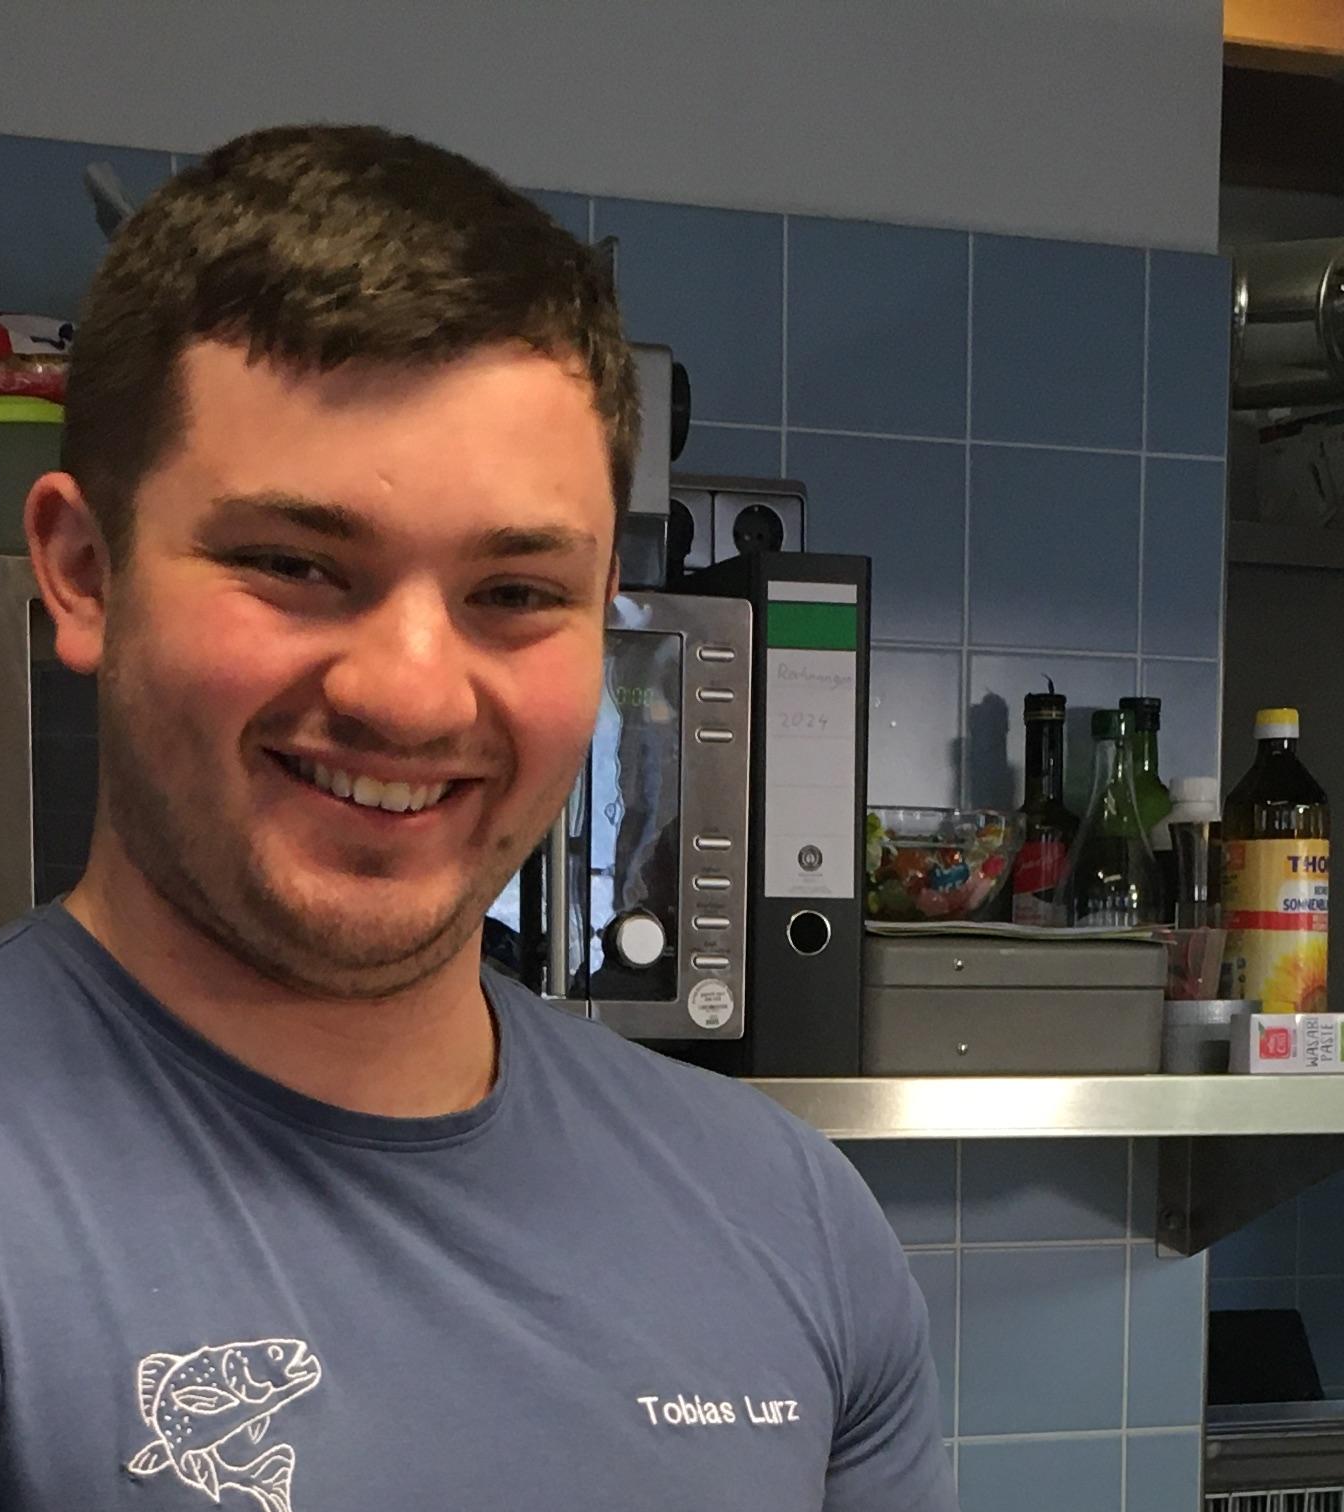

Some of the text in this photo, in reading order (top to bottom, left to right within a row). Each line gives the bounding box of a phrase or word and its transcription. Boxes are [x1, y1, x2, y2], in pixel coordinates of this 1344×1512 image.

[778, 711, 829, 731] 2024
[1287, 855, 1329, 873] THO
[1304, 1016, 1319, 1068] WASABI
[1319, 1023, 1334, 1062] PASTE
[636, 1393, 800, 1425] Tobias Lurz
